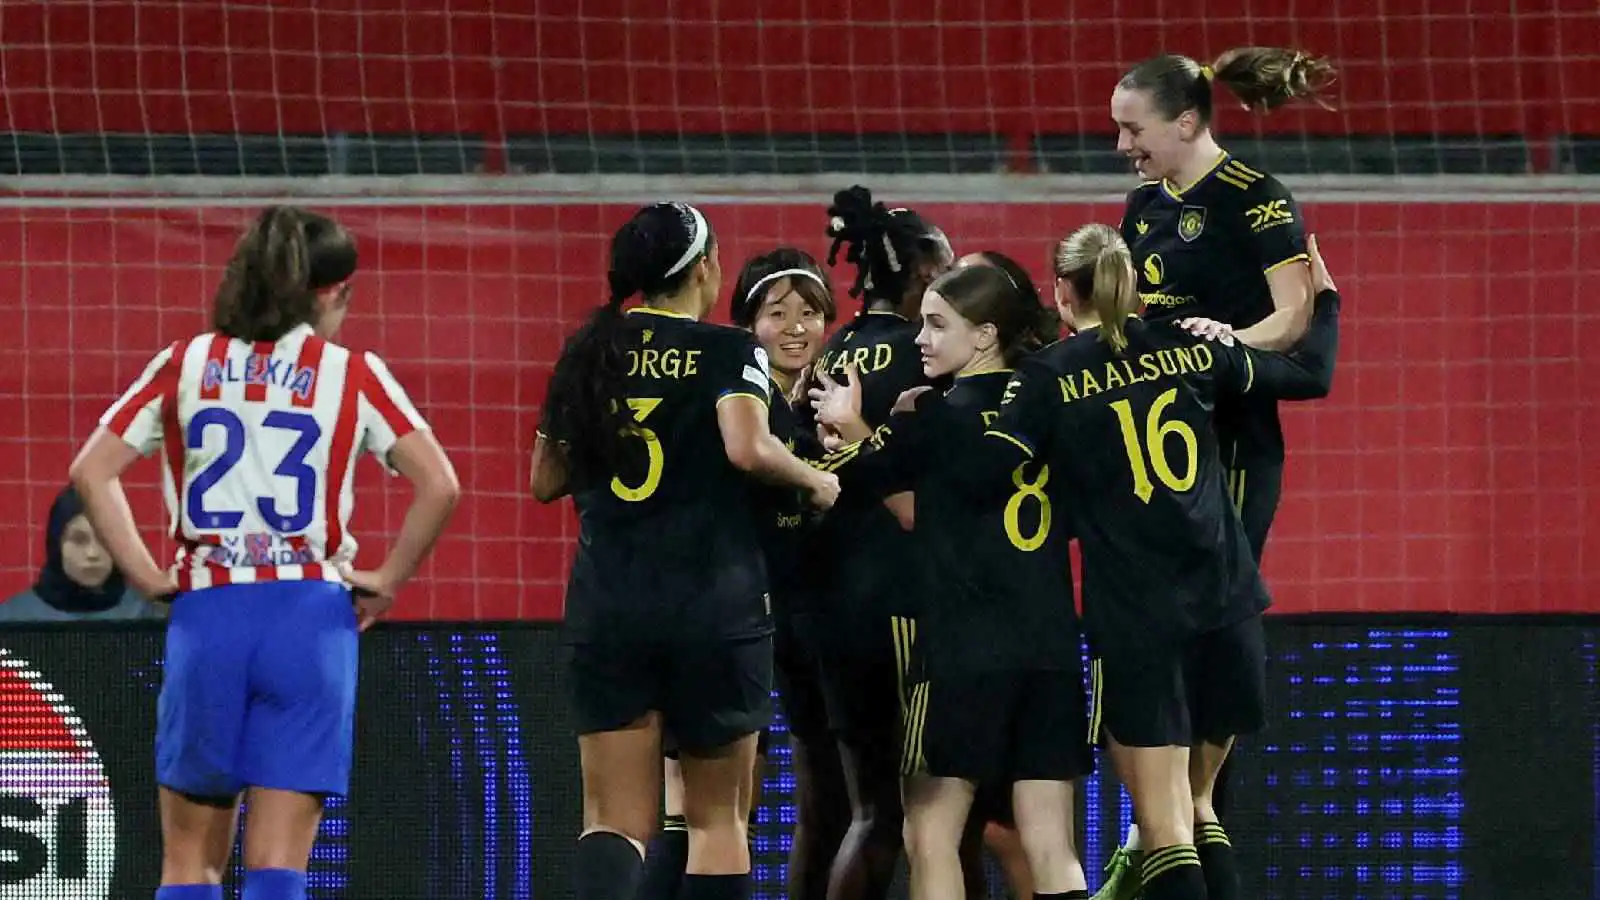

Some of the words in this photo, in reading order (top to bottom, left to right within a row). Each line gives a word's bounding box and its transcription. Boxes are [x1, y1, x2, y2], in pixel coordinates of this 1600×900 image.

[204, 353, 314, 399] ALEXIA
[1058, 343, 1213, 403] NAALSUND
[187, 407, 321, 533] 23
[611, 397, 664, 502] 3
[1108, 387, 1198, 504] 16
[1004, 460, 1051, 551] 8
